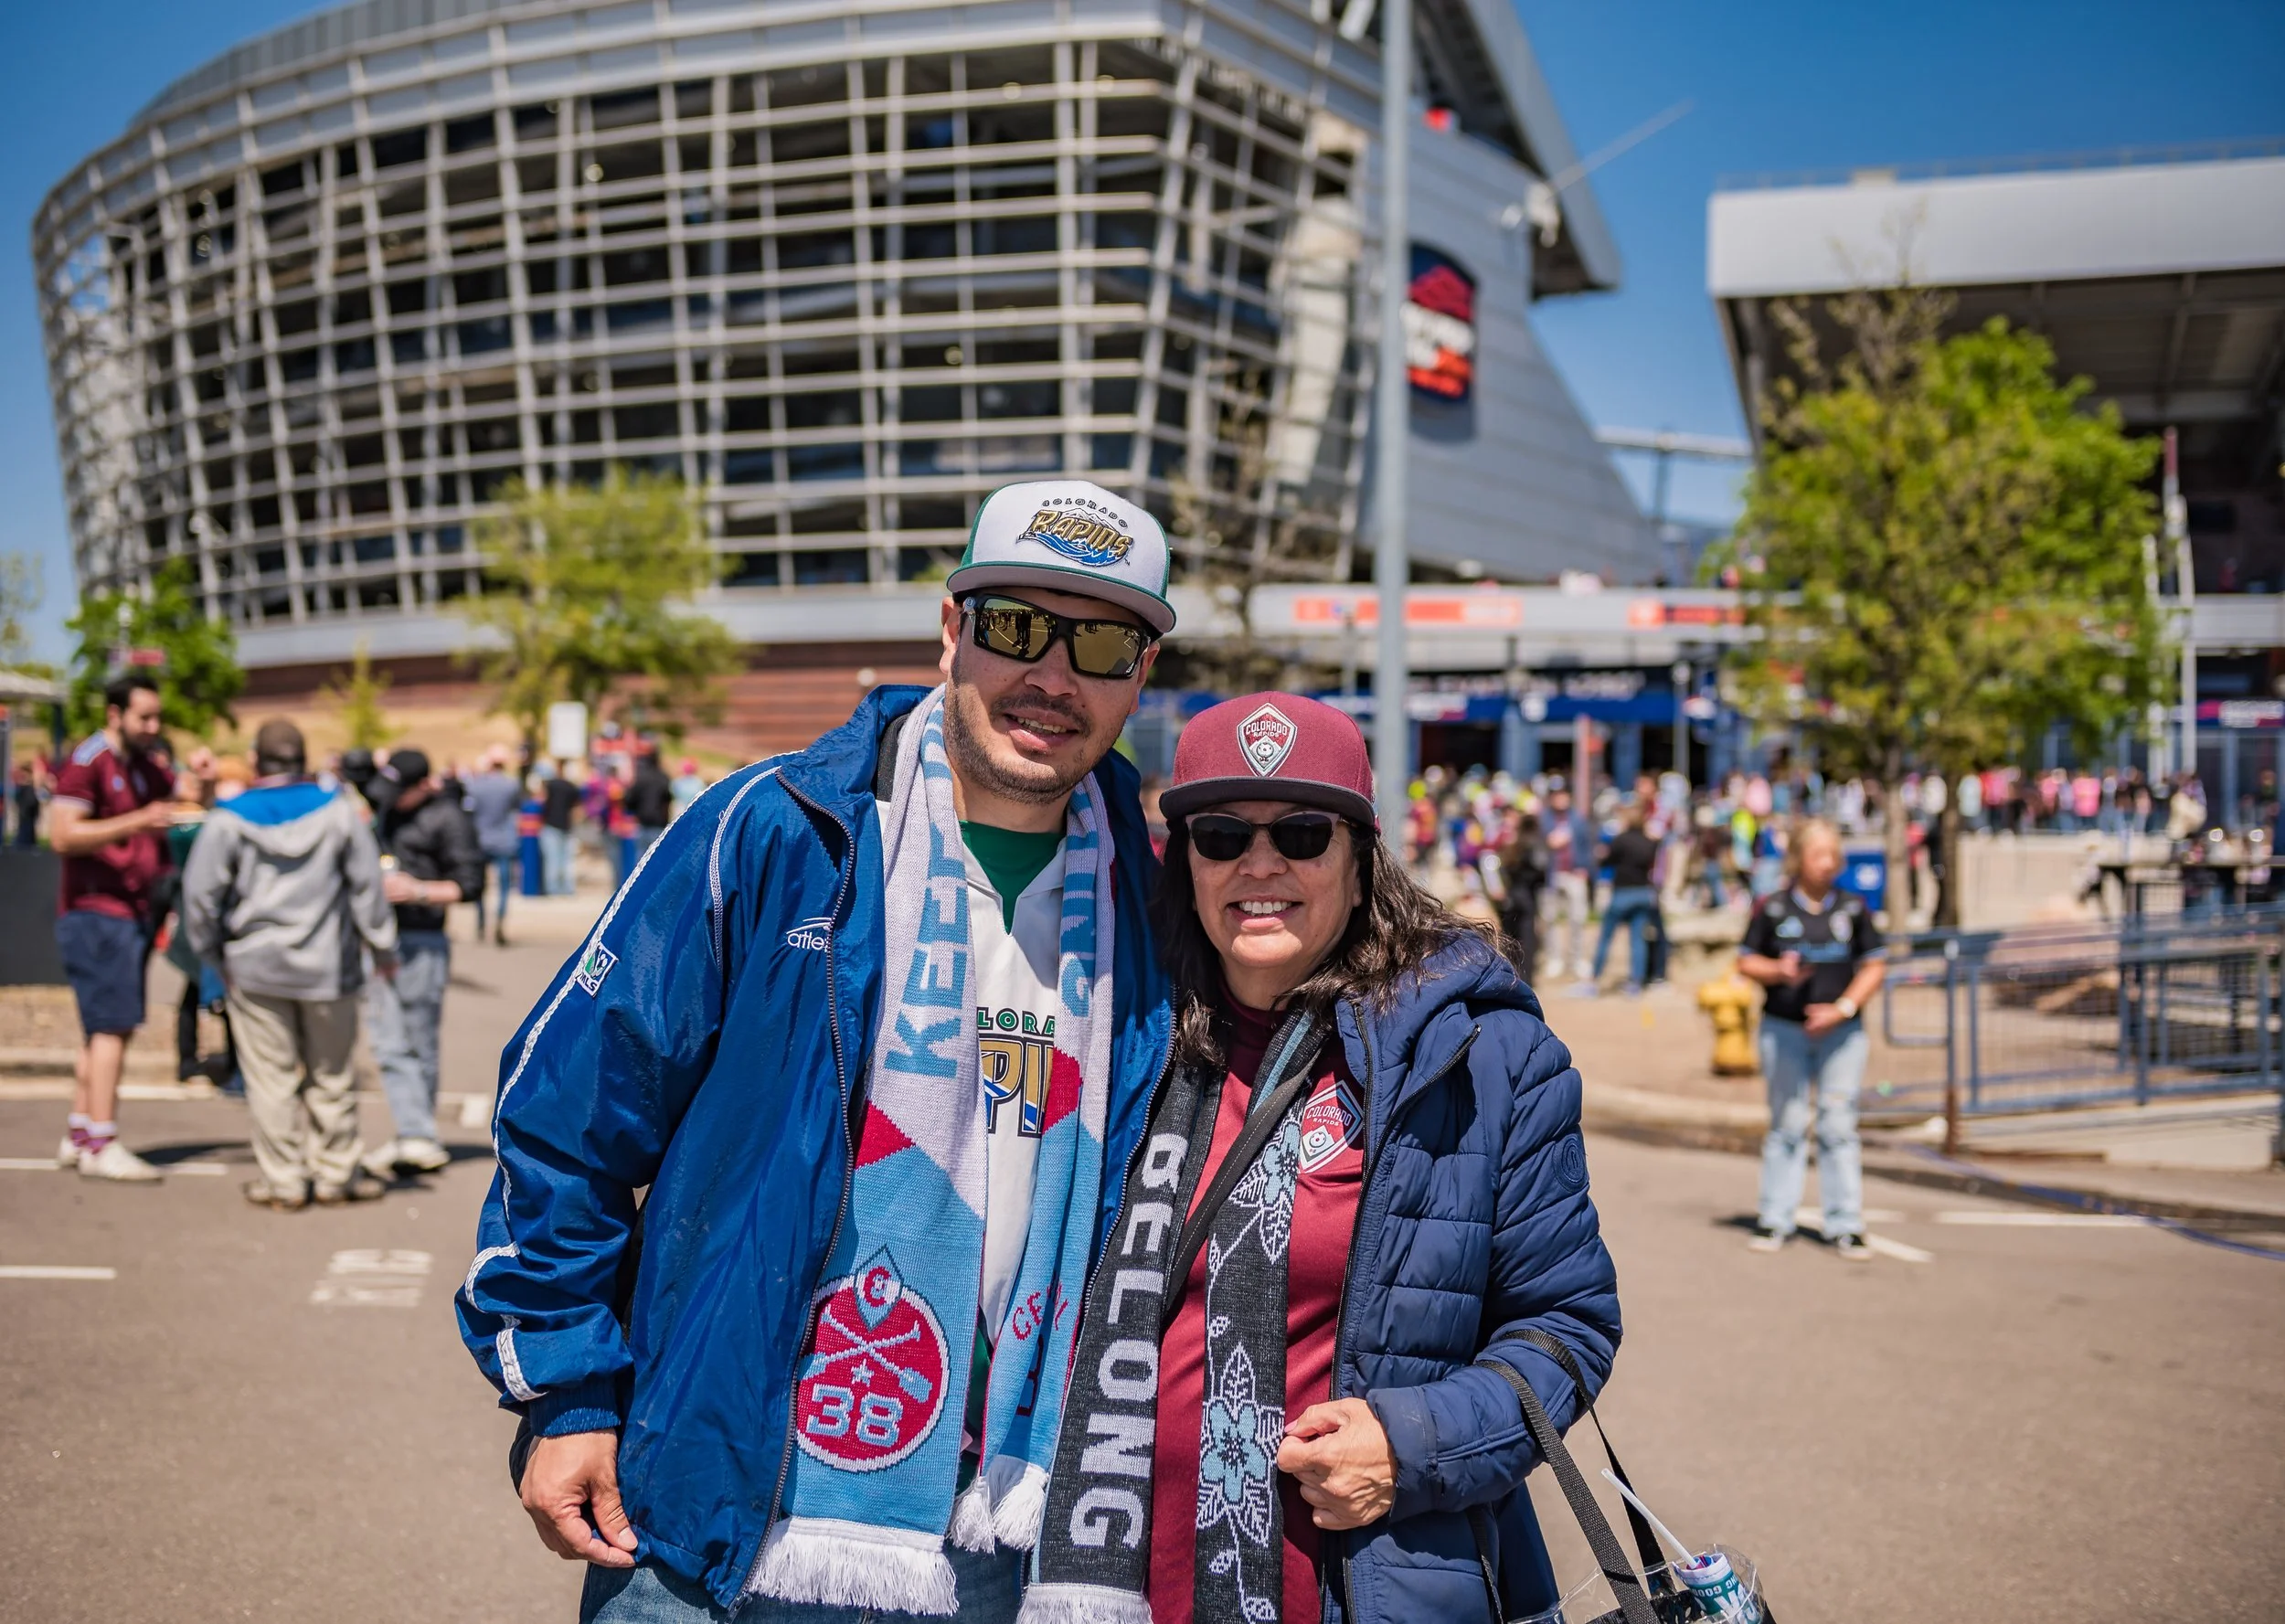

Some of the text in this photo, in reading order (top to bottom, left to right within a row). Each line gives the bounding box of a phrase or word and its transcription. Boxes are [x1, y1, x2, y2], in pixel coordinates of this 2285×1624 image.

[1042, 497, 1128, 527] COLORADO
[1028, 509, 1133, 557] RAPIDS
[1245, 720, 1288, 735] COLORADO
[1306, 1105, 1352, 1126] COLORADO
[1313, 1117, 1339, 1126] RAPIDS
[1069, 1133, 1188, 1550] BELONG
[805, 1383, 904, 1448] 38
